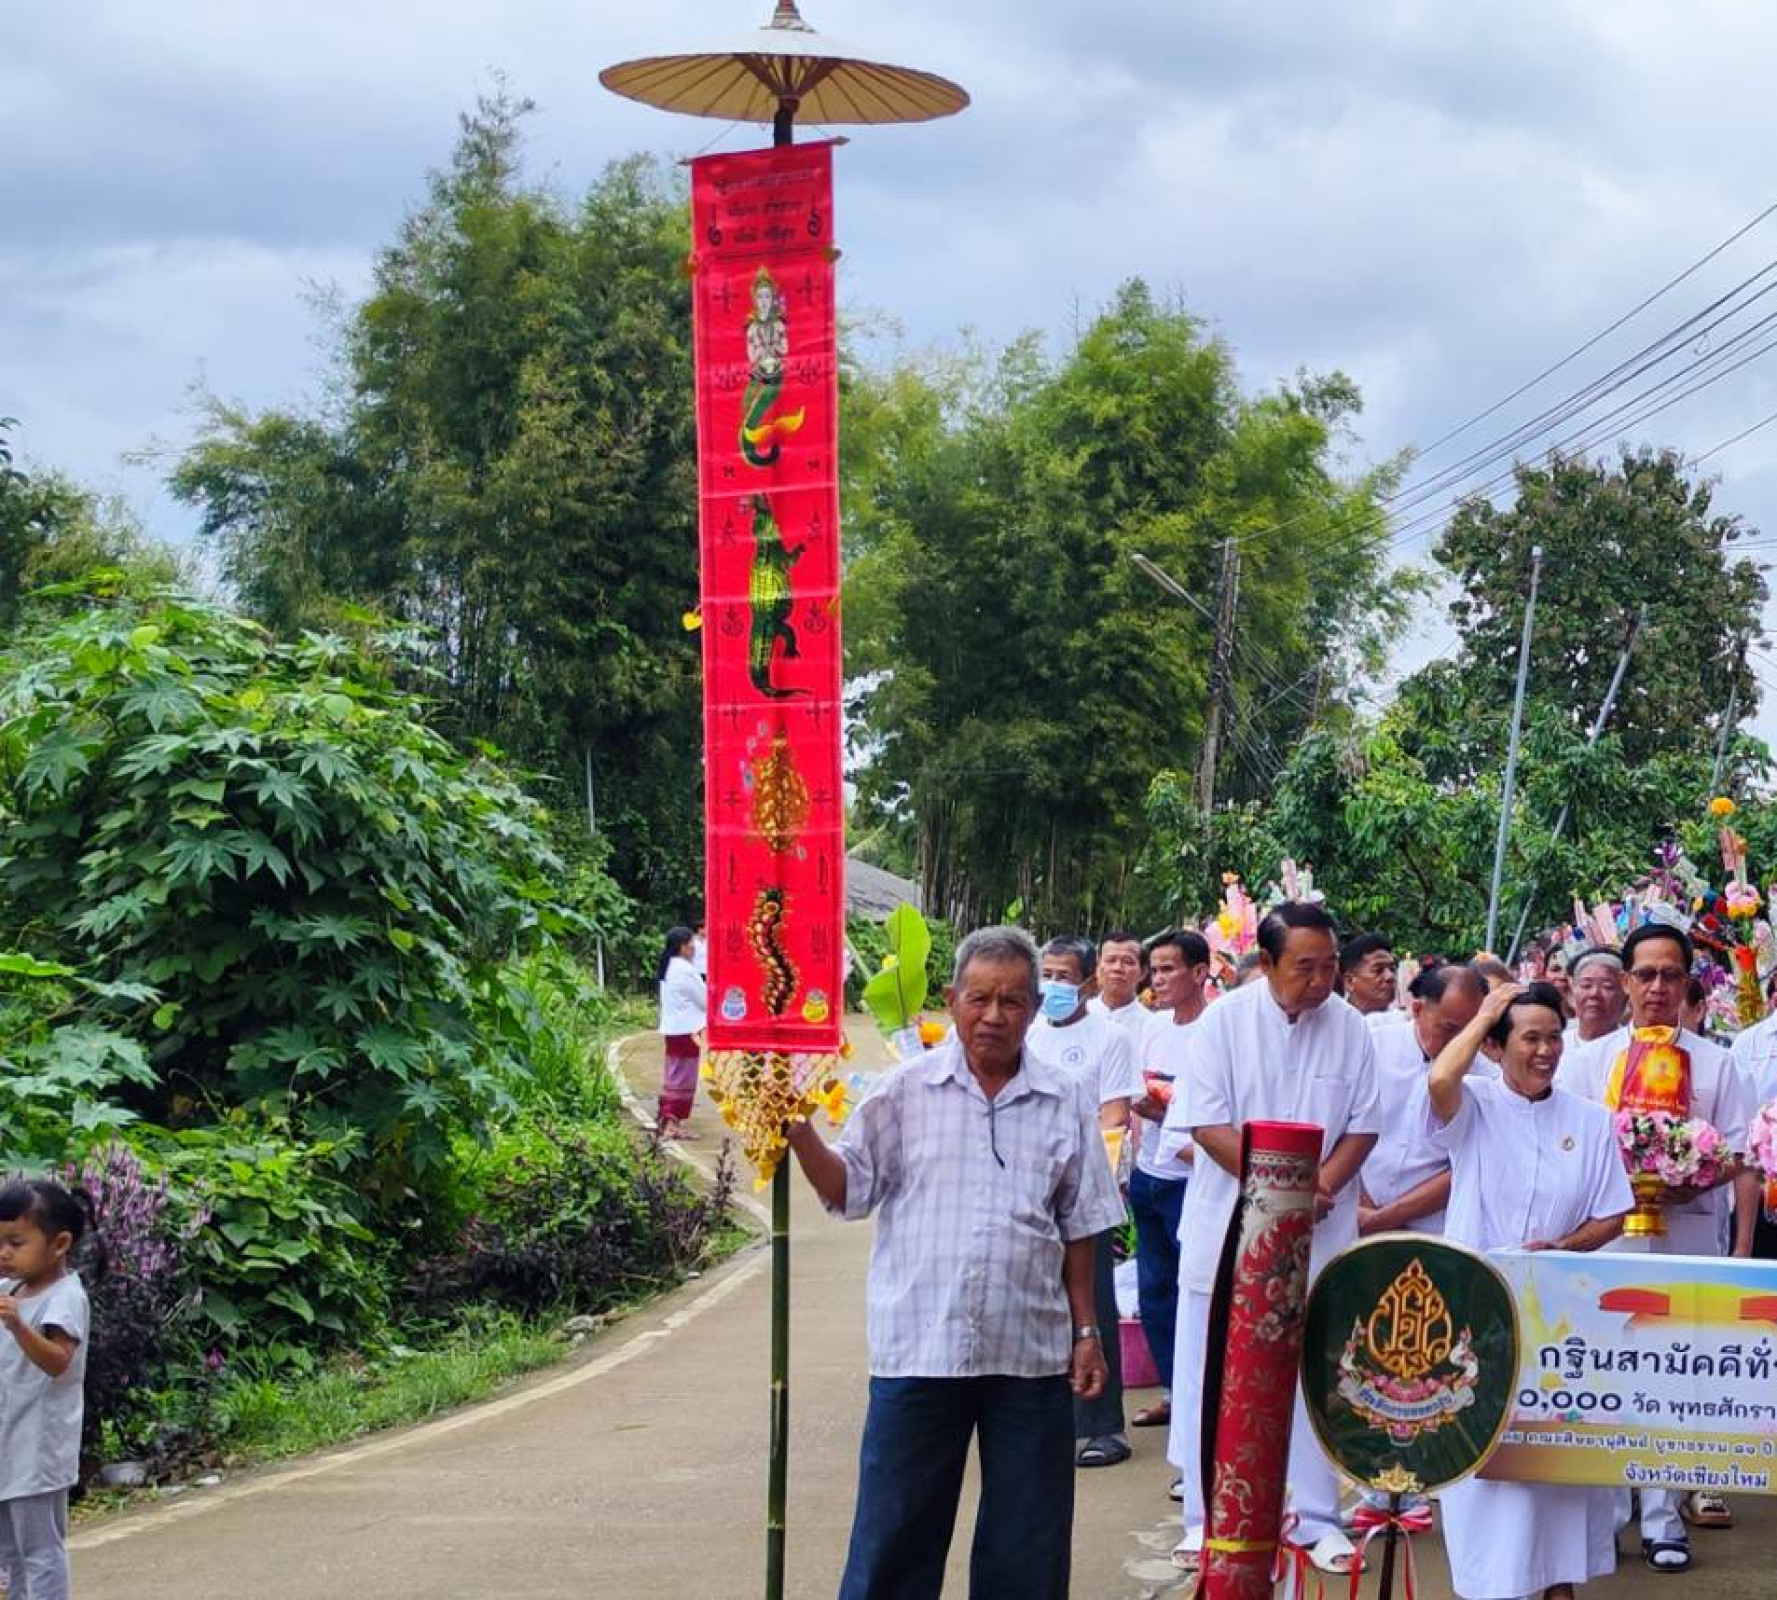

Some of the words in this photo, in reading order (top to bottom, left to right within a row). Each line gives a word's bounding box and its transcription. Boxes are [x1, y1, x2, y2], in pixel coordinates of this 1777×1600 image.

[1632, 1391, 1661, 1414] วัด
[1624, 1461, 1769, 1488] จังหวัดเชียงใหม่
